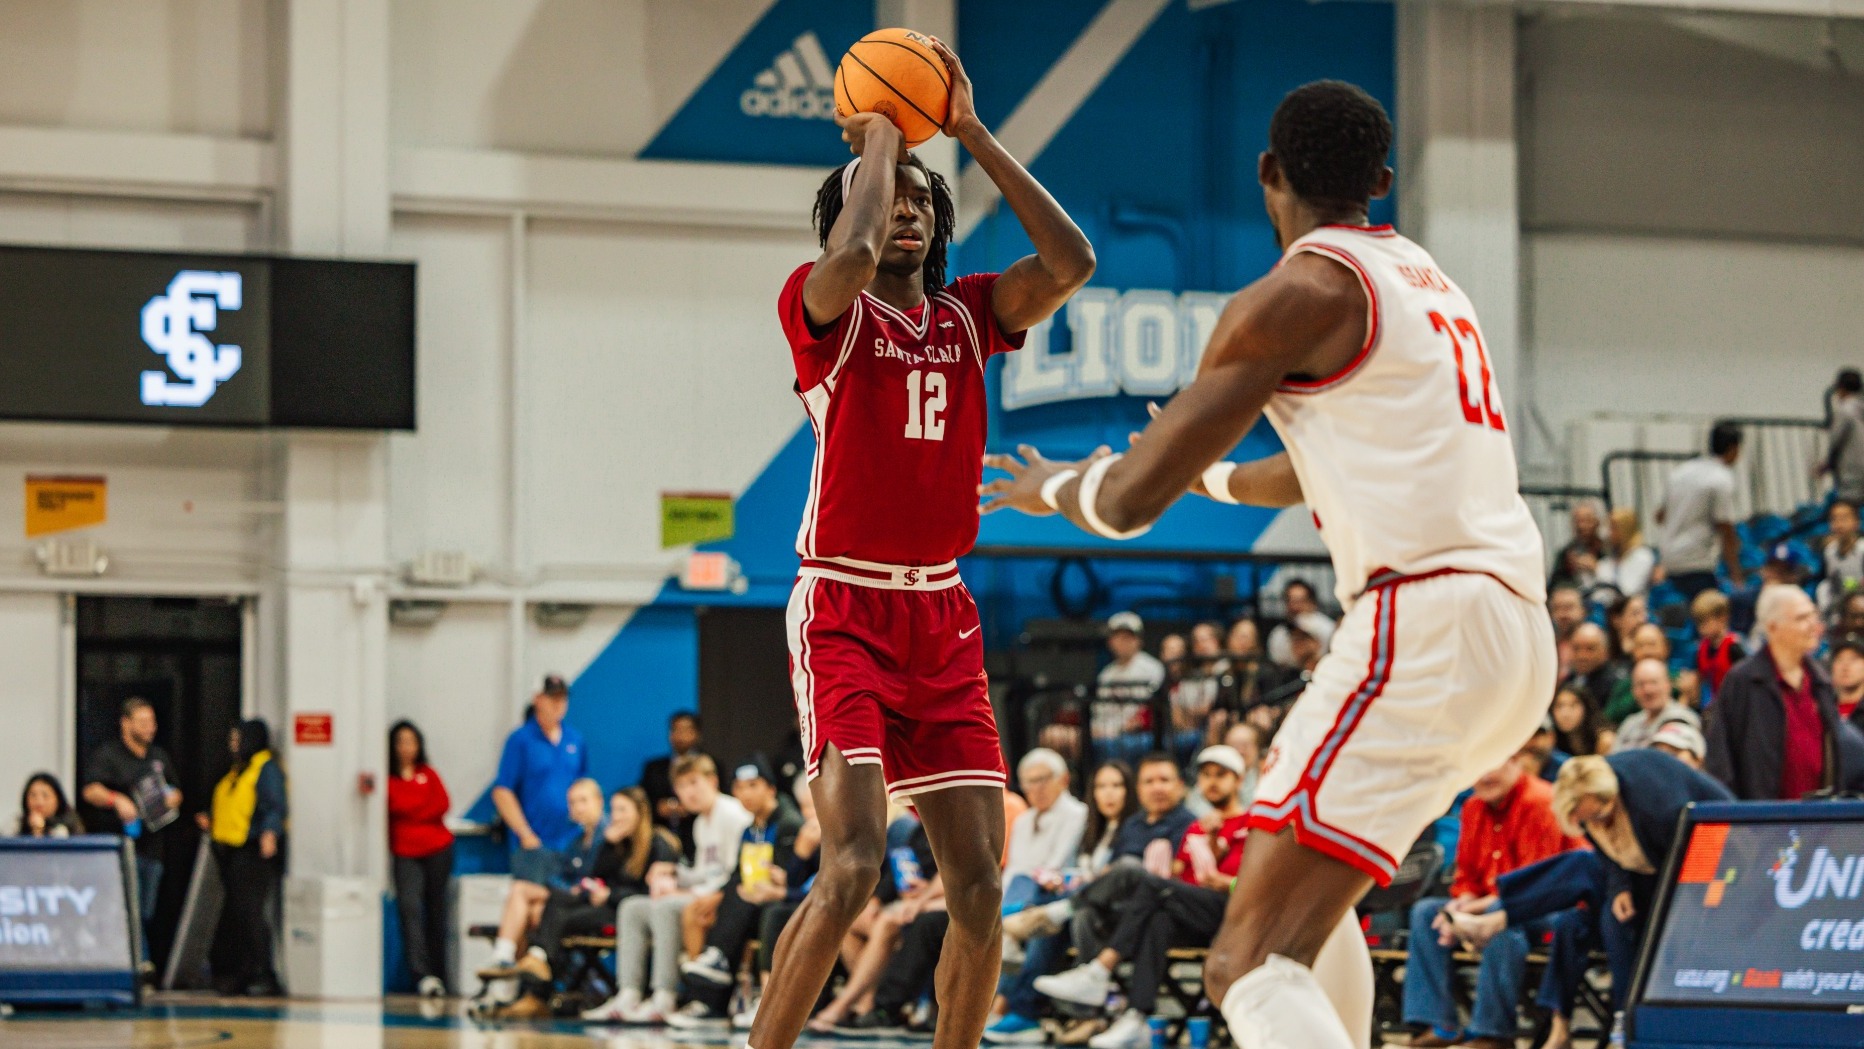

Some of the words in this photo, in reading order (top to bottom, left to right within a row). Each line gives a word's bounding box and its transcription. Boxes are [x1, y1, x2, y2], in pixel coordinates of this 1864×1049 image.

[741, 86, 837, 119] adida
[1428, 311, 1505, 432] 22
[904, 369, 947, 441] 12
[0, 886, 97, 916] SITY
[0, 917, 50, 945] ion
